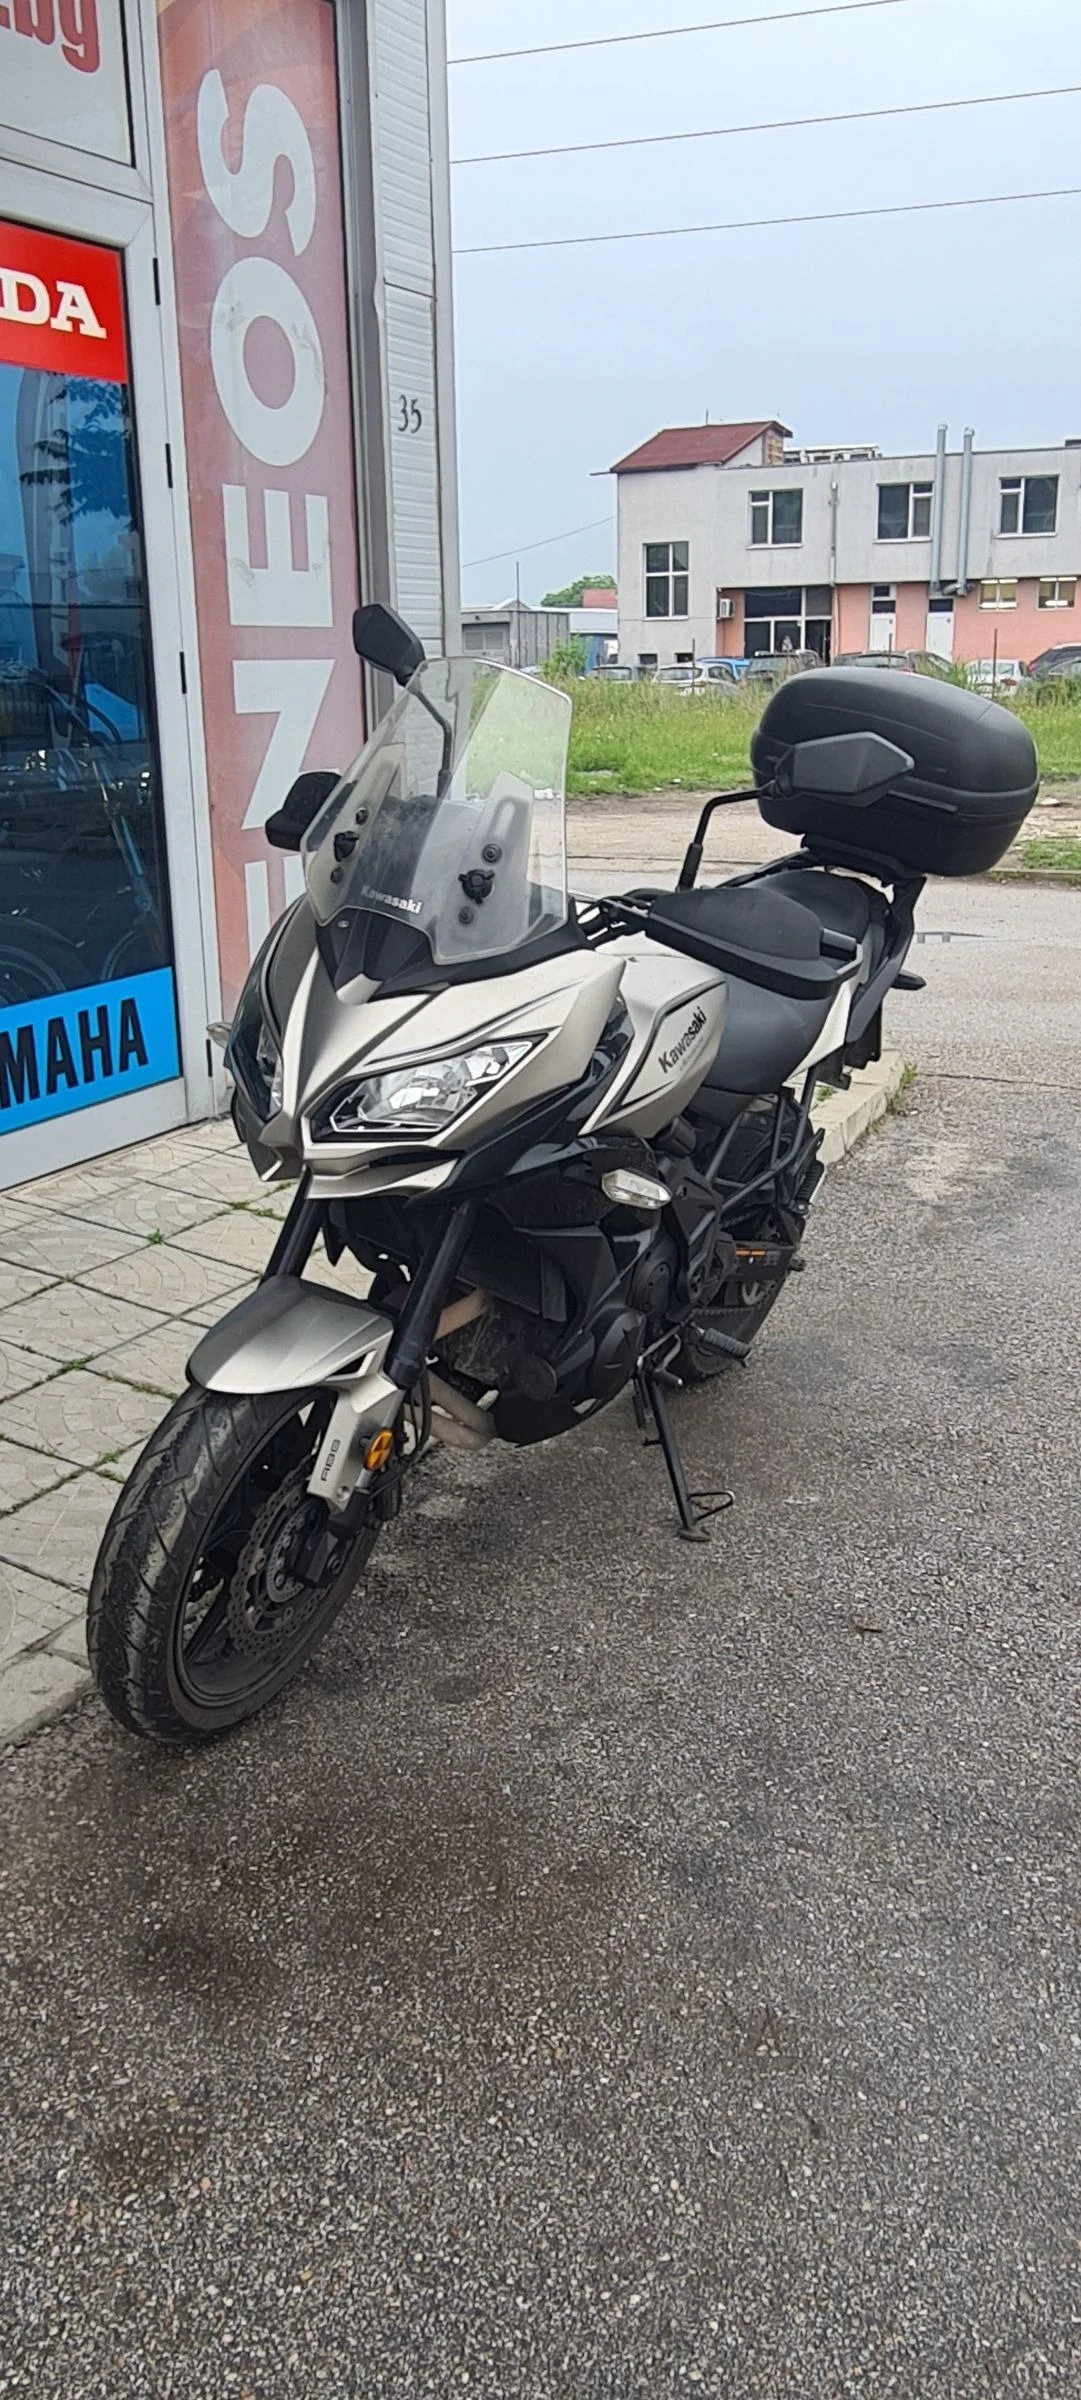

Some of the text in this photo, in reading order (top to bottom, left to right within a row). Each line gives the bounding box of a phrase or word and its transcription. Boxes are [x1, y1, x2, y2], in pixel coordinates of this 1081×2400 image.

[397, 394, 422, 434] 35
[360, 885, 422, 914] Kawasaki
[0, 997, 149, 1110] MAHA
[658, 1006, 707, 1074] Kawasaki
